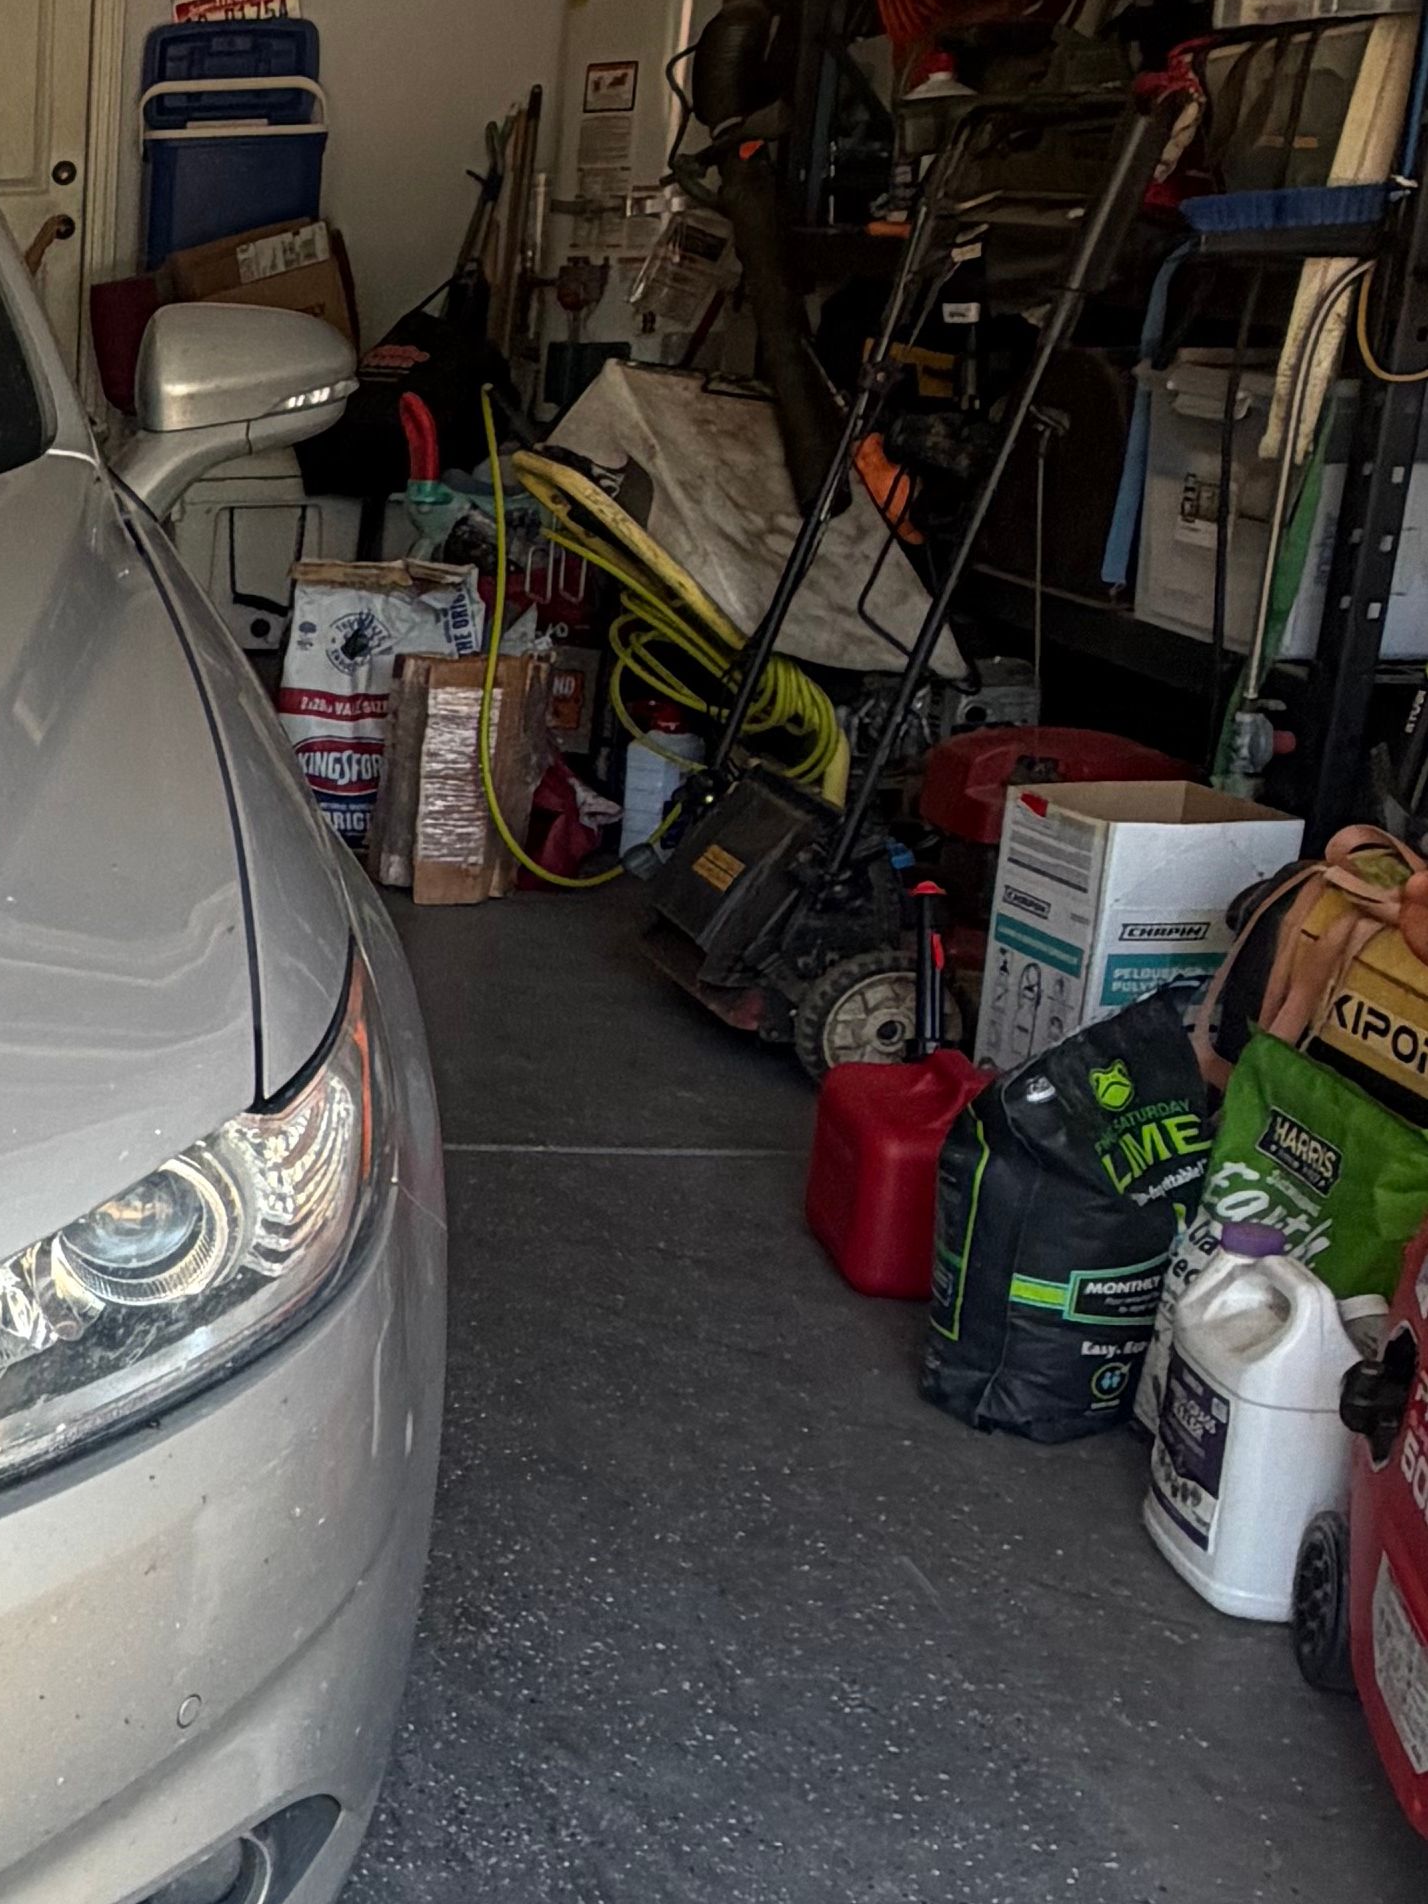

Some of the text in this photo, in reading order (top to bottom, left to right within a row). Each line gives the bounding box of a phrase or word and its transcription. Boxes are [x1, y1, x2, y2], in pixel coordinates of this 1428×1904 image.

[298, 749, 383, 786] KINGSFOR
[1127, 926, 1203, 938] CHAPIN
[1101, 1113, 1213, 1195] LIME
[1273, 1116, 1336, 1178] HARRIS
